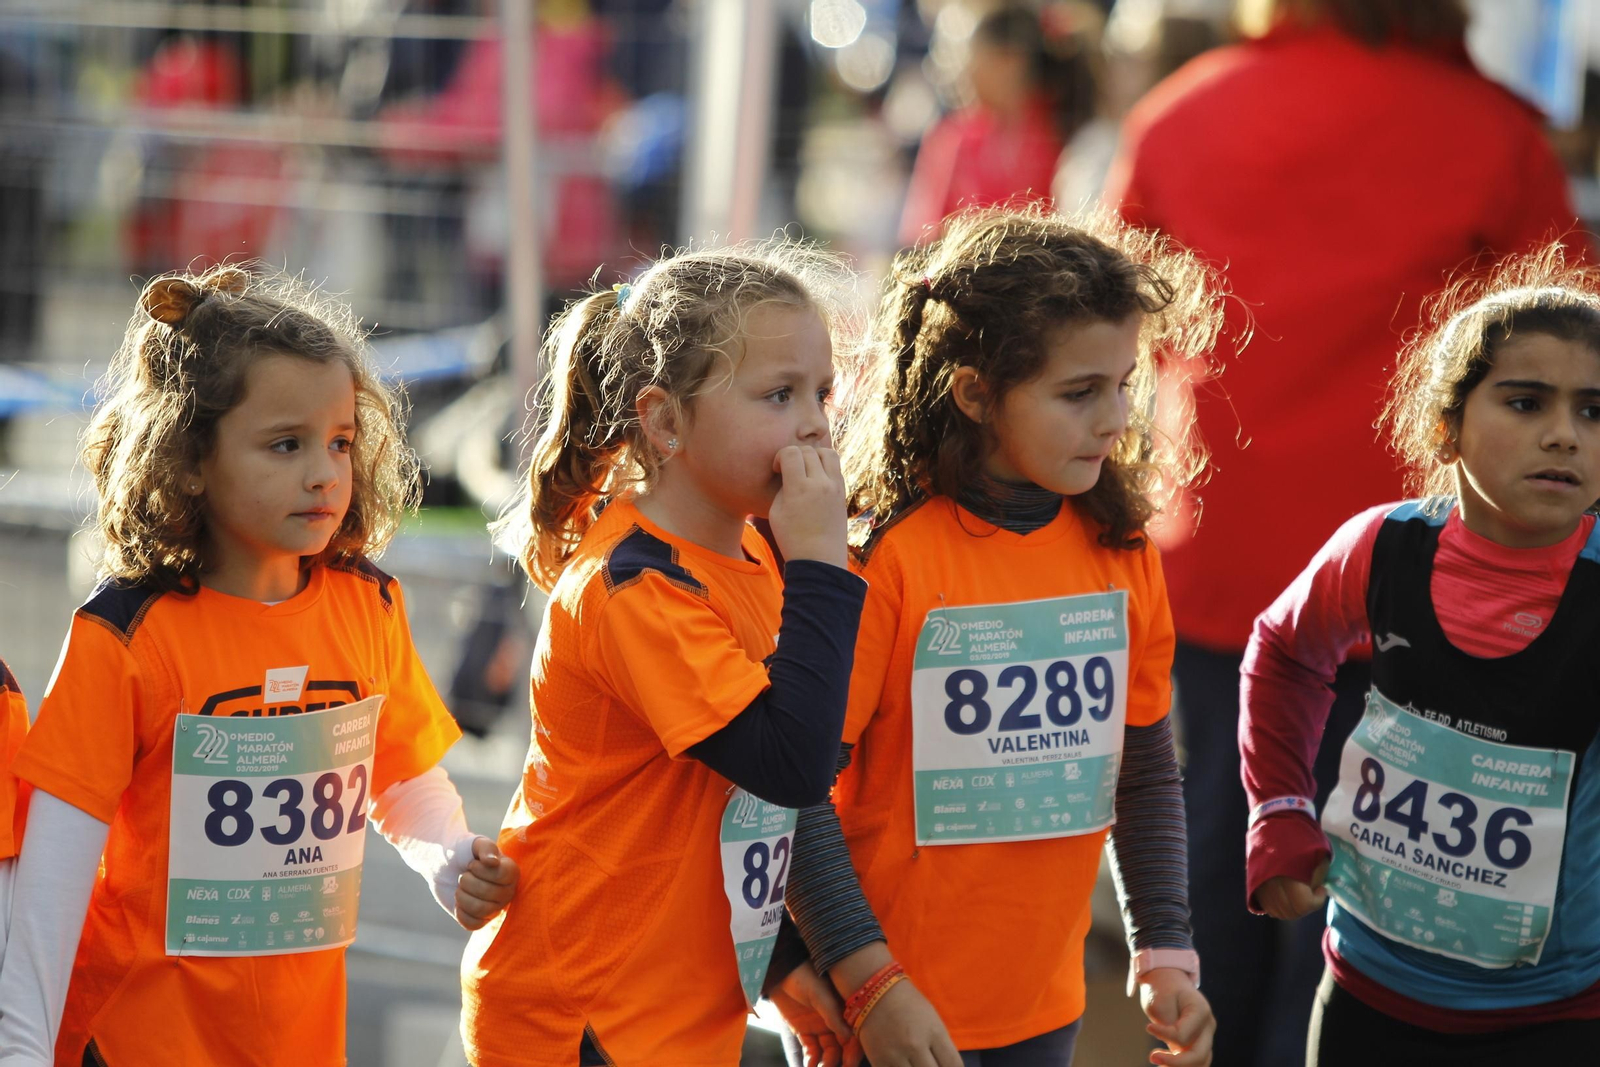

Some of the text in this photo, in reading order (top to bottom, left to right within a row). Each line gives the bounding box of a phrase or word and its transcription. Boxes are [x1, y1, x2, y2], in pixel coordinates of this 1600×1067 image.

[968, 620, 1004, 630] MEDIO
[1059, 608, 1115, 626] CARRERA
[968, 628, 1023, 642] MARATÓN
[1064, 627, 1117, 644] INFANTIL
[969, 639, 1018, 654] ALMERÍA
[944, 656, 1115, 736] 8289
[332, 714, 371, 737] CARRERA
[1456, 718, 1508, 742] ATLETISMO
[237, 732, 275, 742] MEDIO
[334, 736, 371, 755] INFANTIL
[988, 728, 1091, 755] VALENTINA
[236, 741, 294, 753] MARATÓN
[236, 753, 288, 765] ALMERÍA
[1001, 751, 1082, 765] VALENTINA PEREZ SALAS
[1471, 753, 1552, 778] CARRERA
[236, 764, 279, 773] 03/02/2019
[932, 777, 964, 790] NEXA
[971, 774, 996, 787] CDX
[1471, 772, 1549, 797] INFANTIL
[204, 764, 367, 847] 8382
[1352, 757, 1534, 870] 8436
[283, 846, 324, 866] ANA
[1349, 822, 1407, 860] CARLA
[1412, 847, 1508, 889] SANCHEZ
[262, 864, 339, 879] ANA SERRANO FUENTES
[186, 884, 312, 901] NEXA CDX ALMERÍA
[186, 915, 220, 925] Blanes
[197, 934, 229, 944] cajamar
